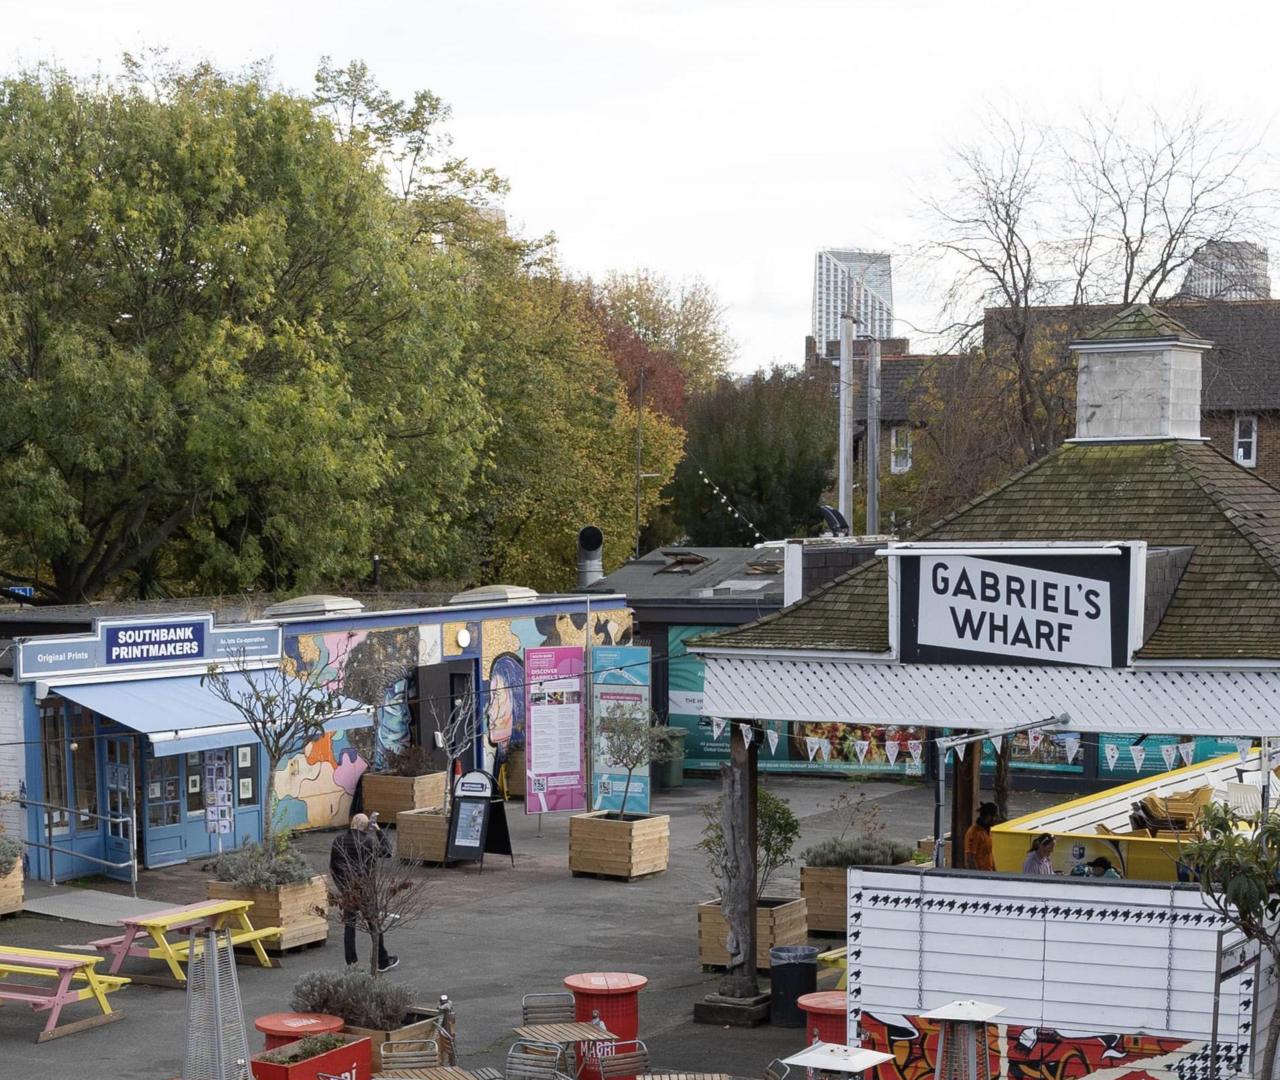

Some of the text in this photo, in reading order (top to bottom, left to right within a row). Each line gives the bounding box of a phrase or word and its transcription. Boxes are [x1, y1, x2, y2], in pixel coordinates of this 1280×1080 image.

[931, 561, 1102, 620] GABRIEL'S
[118, 627, 194, 643] SOUTHBANK
[949, 606, 1073, 653] WHARF
[37, 651, 89, 664] Original Prints
[111, 641, 199, 660] PRINTMAKERS
